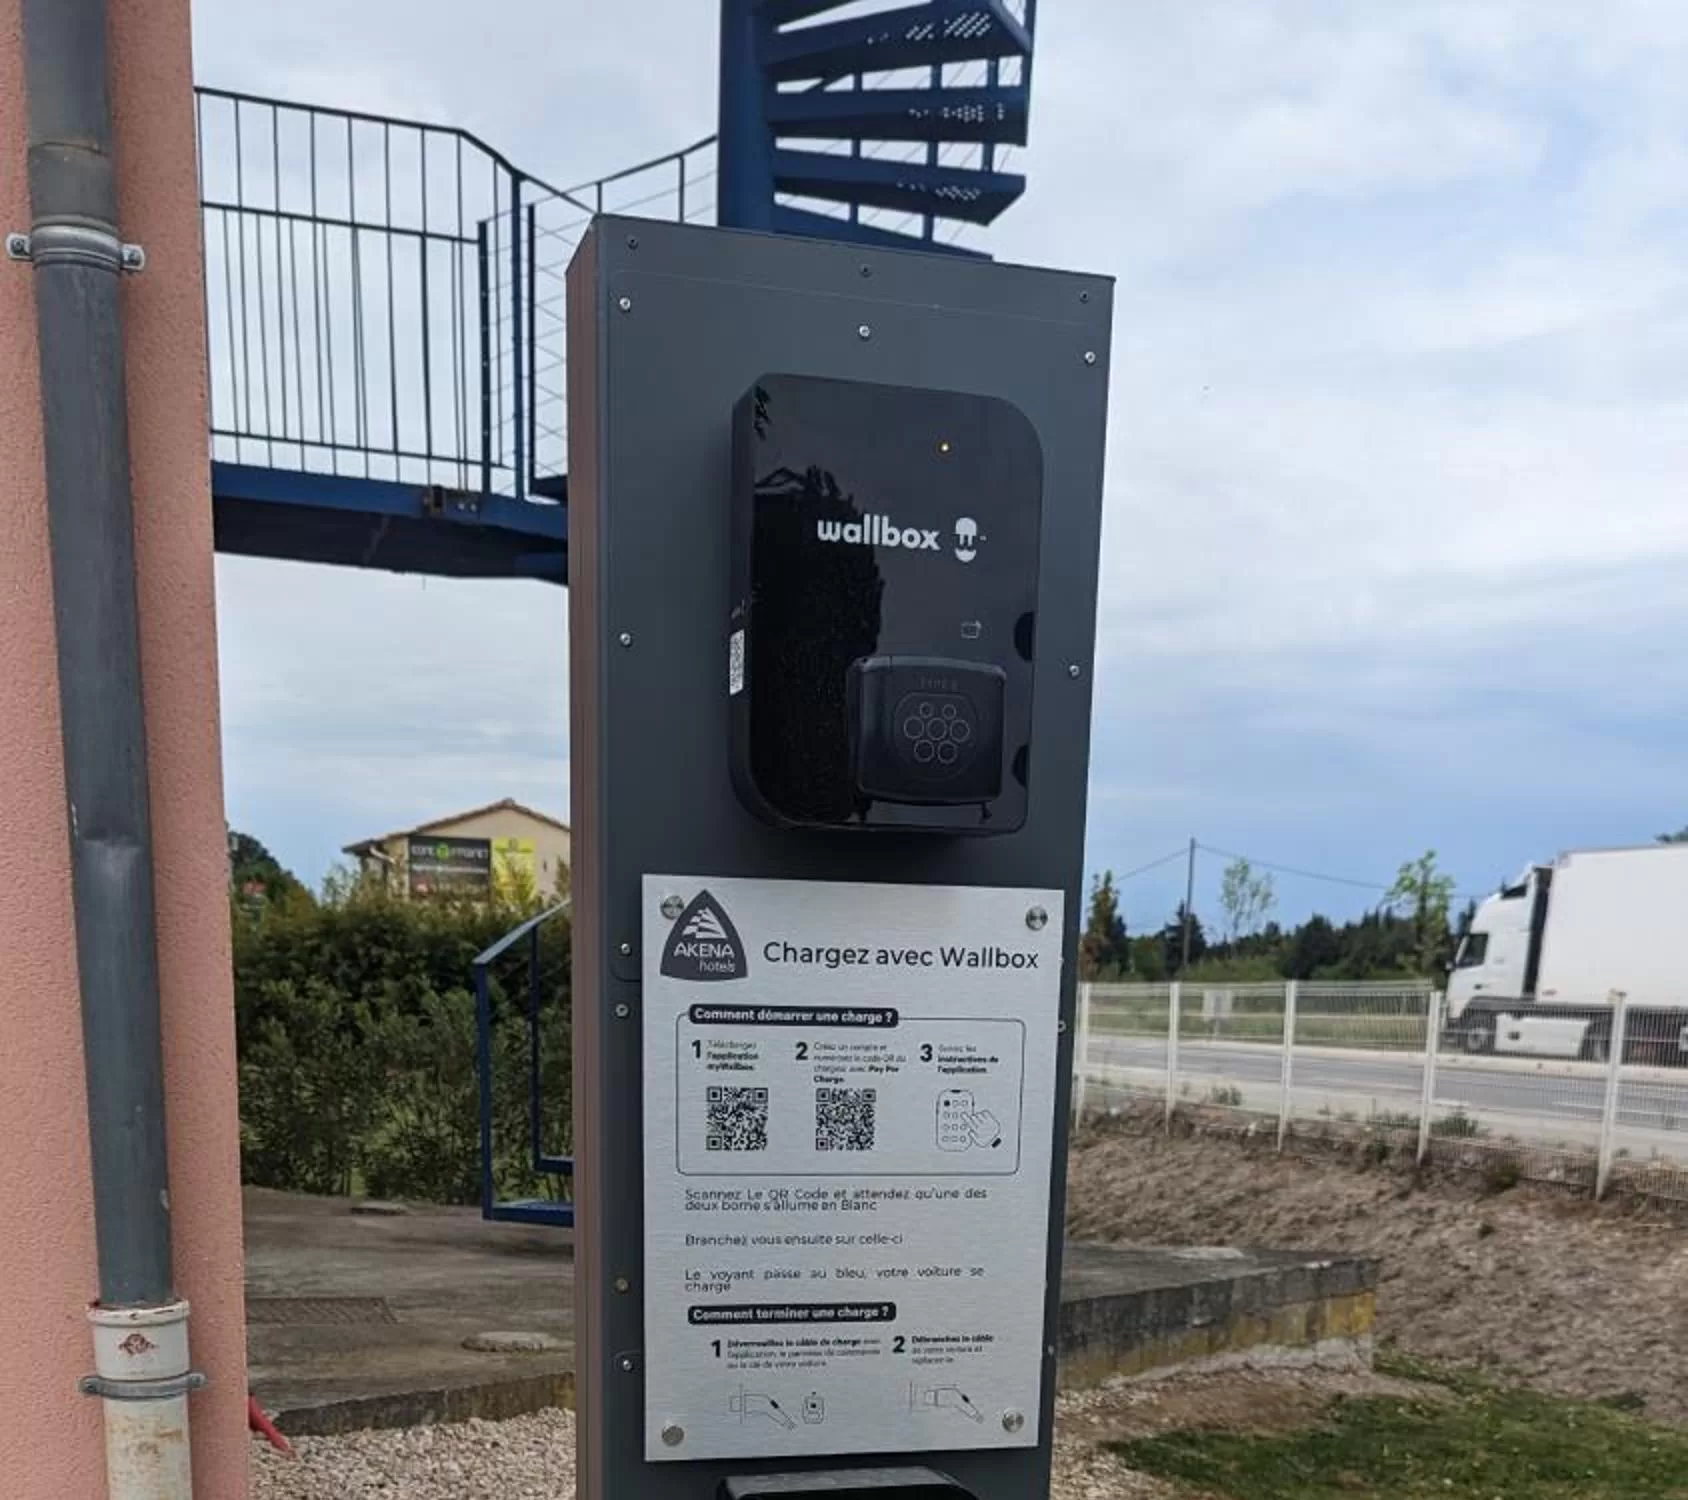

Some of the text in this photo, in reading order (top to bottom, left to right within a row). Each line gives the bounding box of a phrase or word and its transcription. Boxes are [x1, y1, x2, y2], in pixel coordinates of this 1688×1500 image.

[816, 512, 941, 550] wallbox
[673, 942, 735, 958] AKENA
[762, 941, 1039, 969] Chargez avec Wallbox
[699, 958, 736, 973] hotels
[694, 1007, 893, 1025] Comment démarrer une charge ?
[691, 1039, 701, 1059] 1
[795, 1041, 809, 1060] 2
[919, 1043, 933, 1063] 3
[684, 1186, 988, 1202] Scannez Le QR Code et attendez qu'une des
[684, 1198, 877, 1211] deux borne s'allume en Blanc
[684, 1233, 903, 1247] Branchez vous ensuite sur celle-ci
[684, 1268, 702, 1281] Le
[709, 1268, 755, 1282] voyant
[764, 1268, 801, 1281] passe
[810, 1268, 827, 1279] au
[875, 1267, 909, 1279] votre
[917, 1266, 962, 1278] voiture
[969, 1266, 985, 1277] se
[684, 1281, 731, 1295] charge
[693, 1305, 889, 1321] Comment terminer une charge ?
[711, 1339, 721, 1358] 1
[892, 1335, 906, 1353] 2
